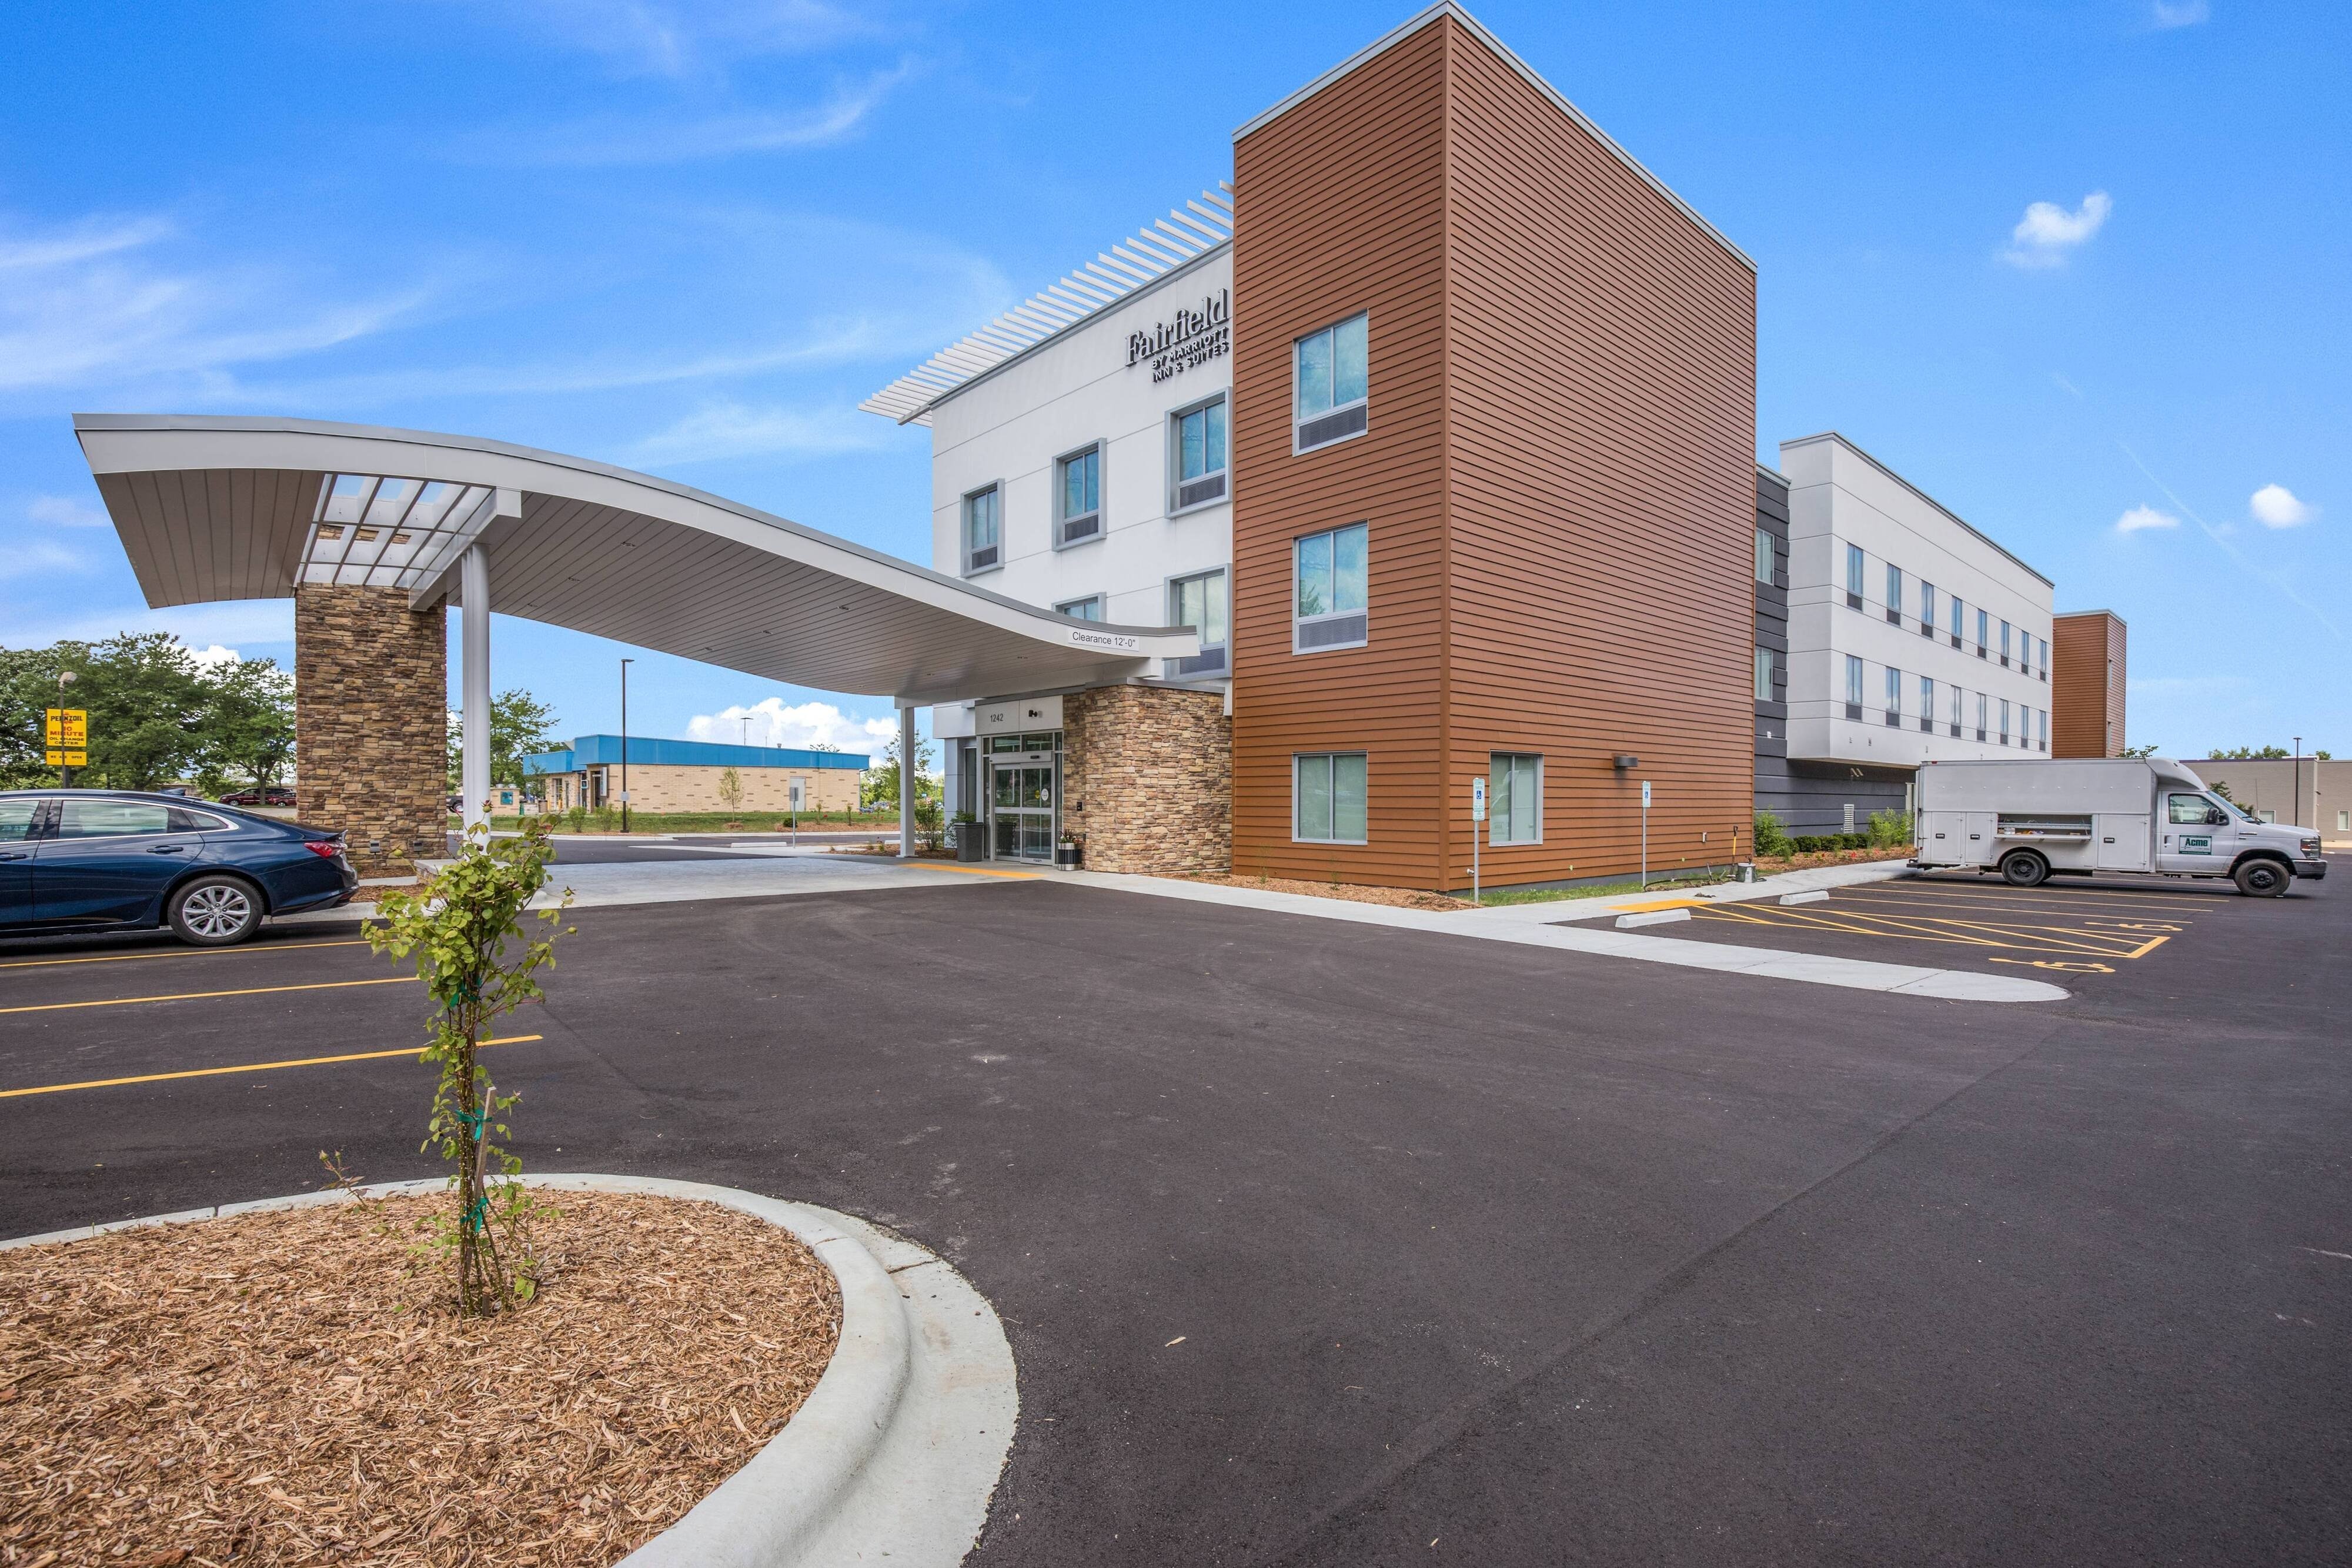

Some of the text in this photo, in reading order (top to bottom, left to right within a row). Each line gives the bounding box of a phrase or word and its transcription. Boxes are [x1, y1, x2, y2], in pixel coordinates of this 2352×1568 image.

[1125, 287, 1228, 367] Fairfield
[1152, 326, 1228, 370] BY MARRIOTT
[1152, 341, 1229, 383] INN & SUITES
[1073, 631, 1135, 647] Clearance 12'-0"
[990, 713, 1004, 723] 1242
[2185, 838, 2208, 847] Acme
